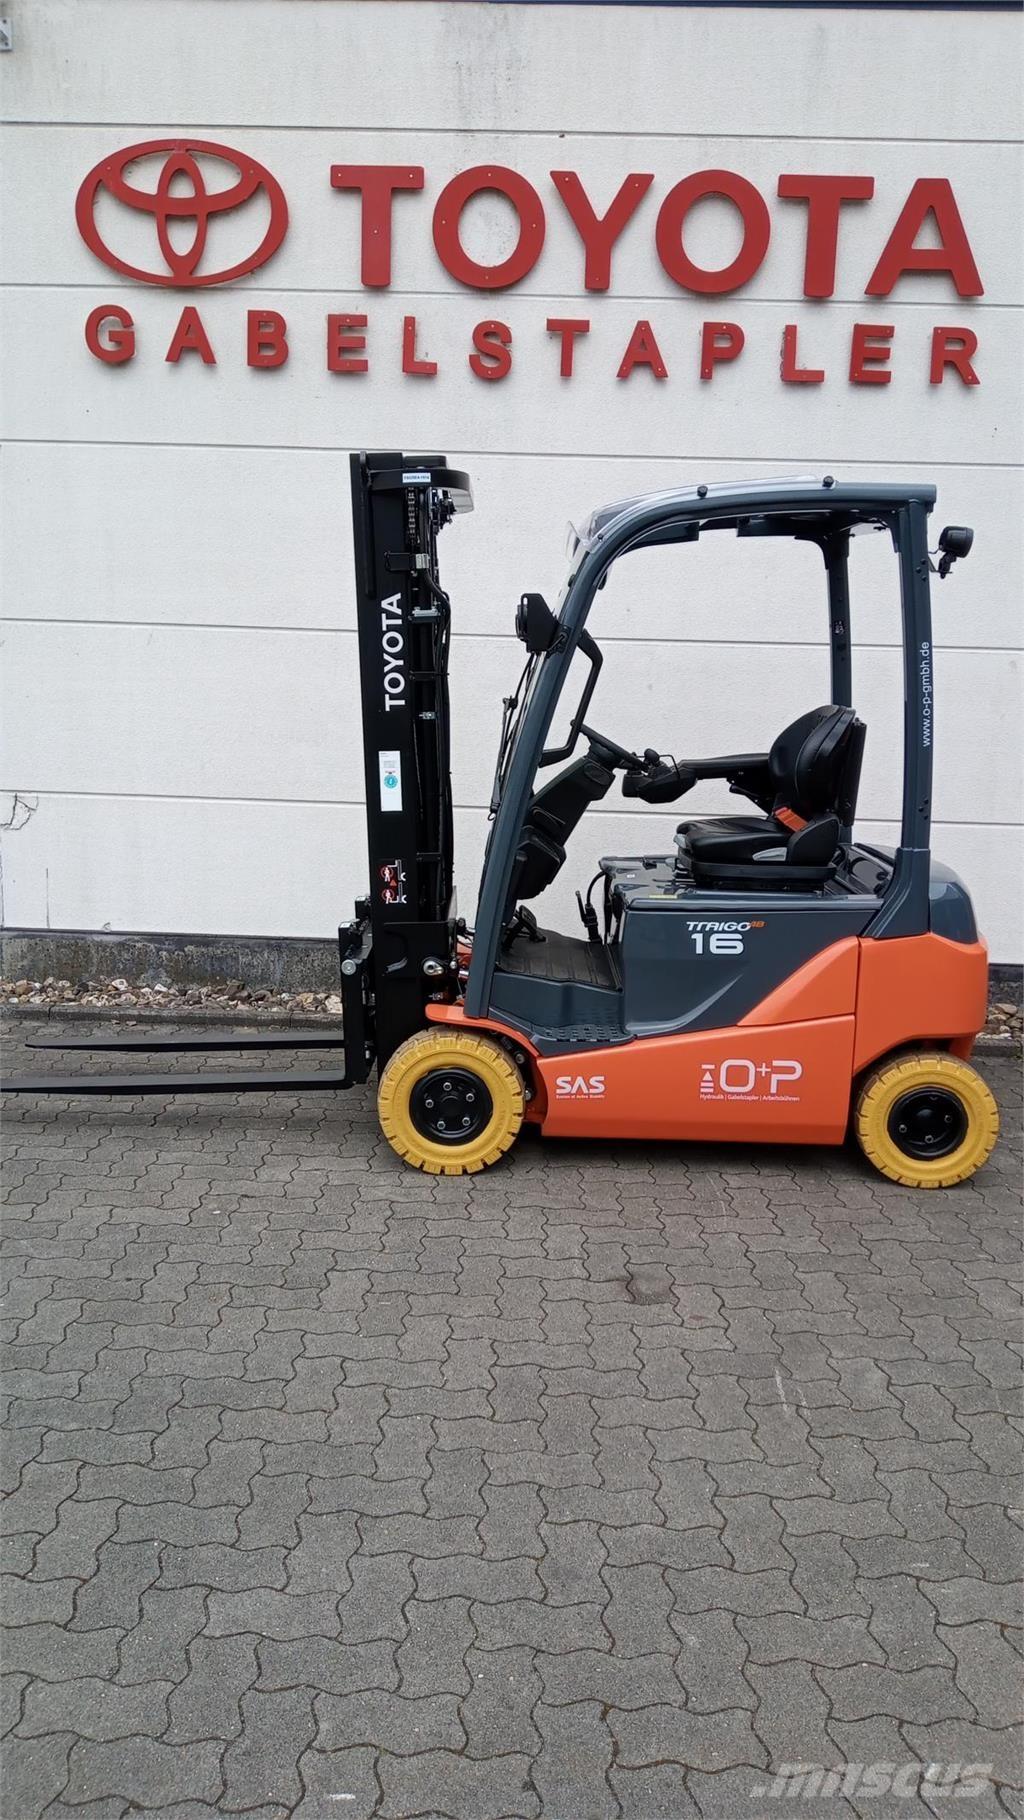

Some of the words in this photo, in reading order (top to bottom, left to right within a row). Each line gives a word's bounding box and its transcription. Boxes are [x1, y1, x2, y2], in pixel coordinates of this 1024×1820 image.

[330, 164, 985, 299] TOYOTA
[84, 304, 980, 386] GABELSTAPLER
[381, 592, 406, 712] TOYOTA
[920, 641, 932, 747] www.o-p-gmbh.de
[691, 932, 744, 955] 16
[555, 1076, 605, 1094] SAS
